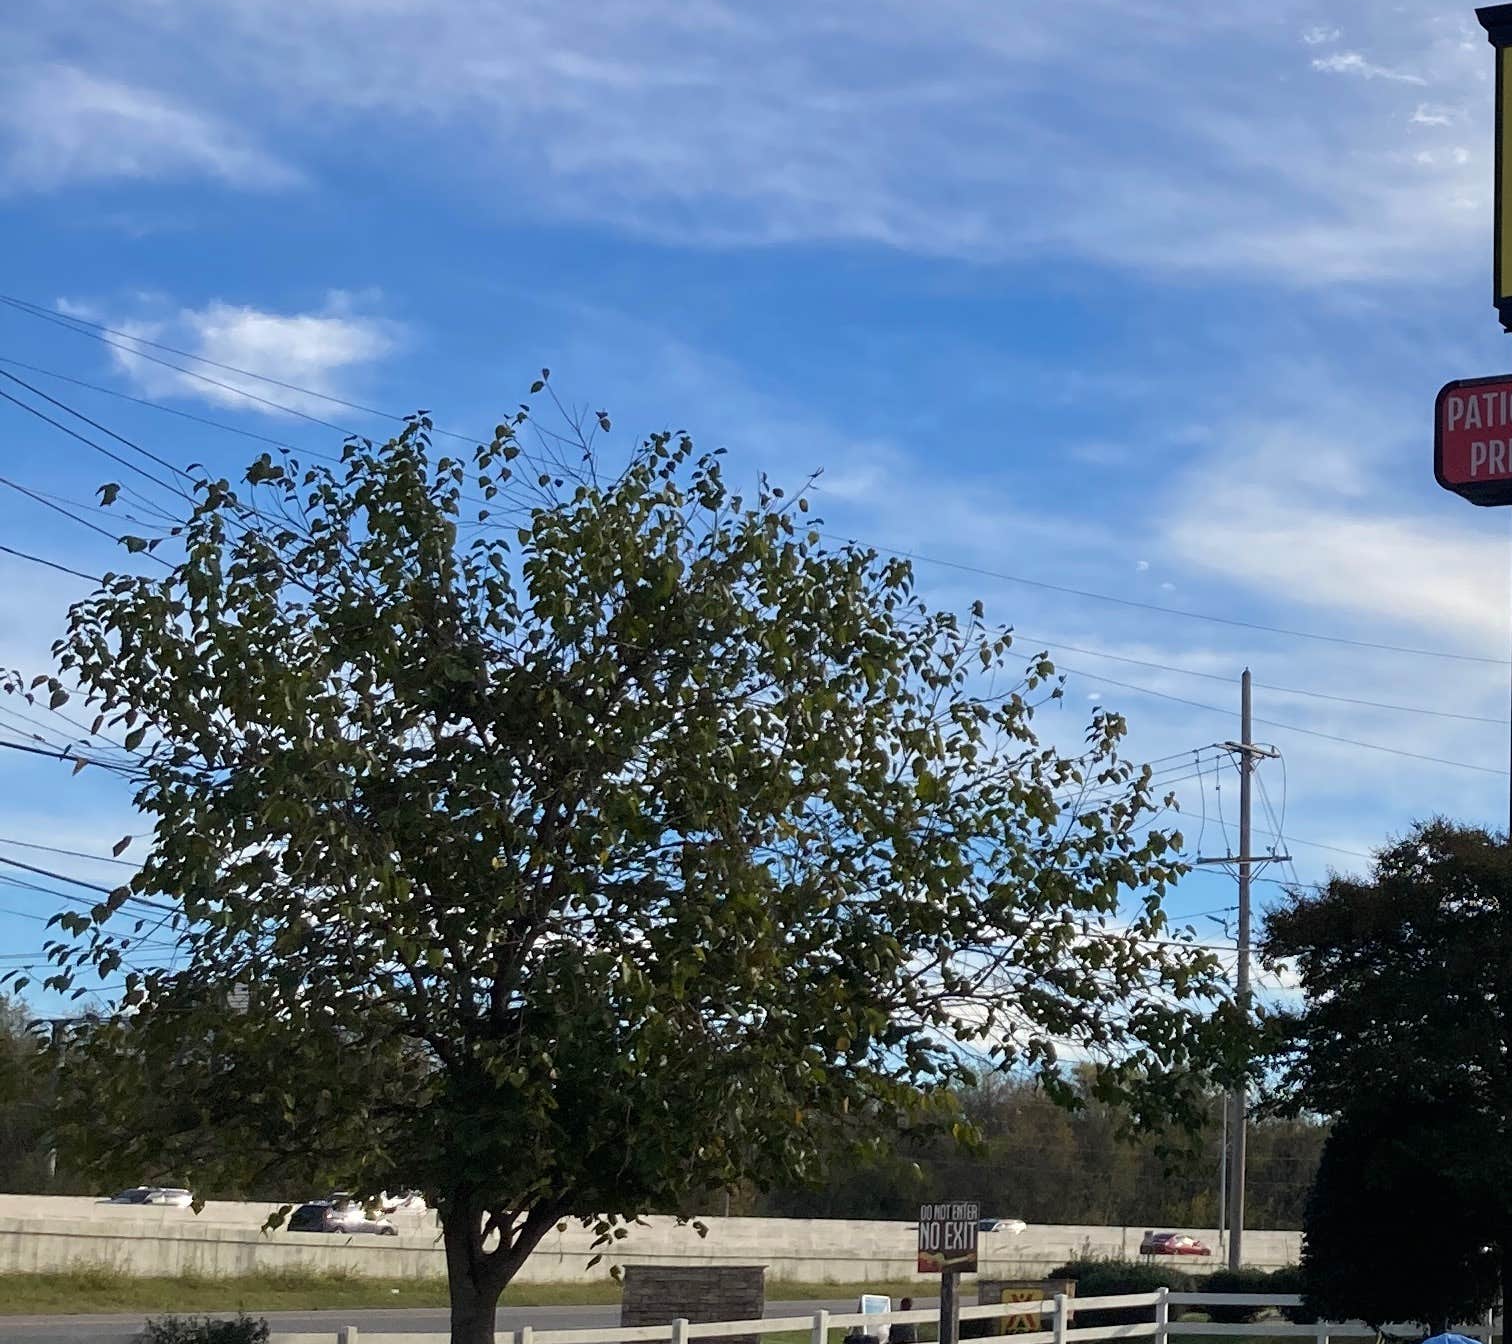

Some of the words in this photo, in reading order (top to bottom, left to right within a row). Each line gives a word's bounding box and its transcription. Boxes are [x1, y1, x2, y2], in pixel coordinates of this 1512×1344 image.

[921, 1204, 933, 1220] DO
[934, 1204, 951, 1220] NOT
[952, 1203, 978, 1220] ENTER
[920, 1221, 940, 1250] NO
[944, 1221, 977, 1250] EXIT
